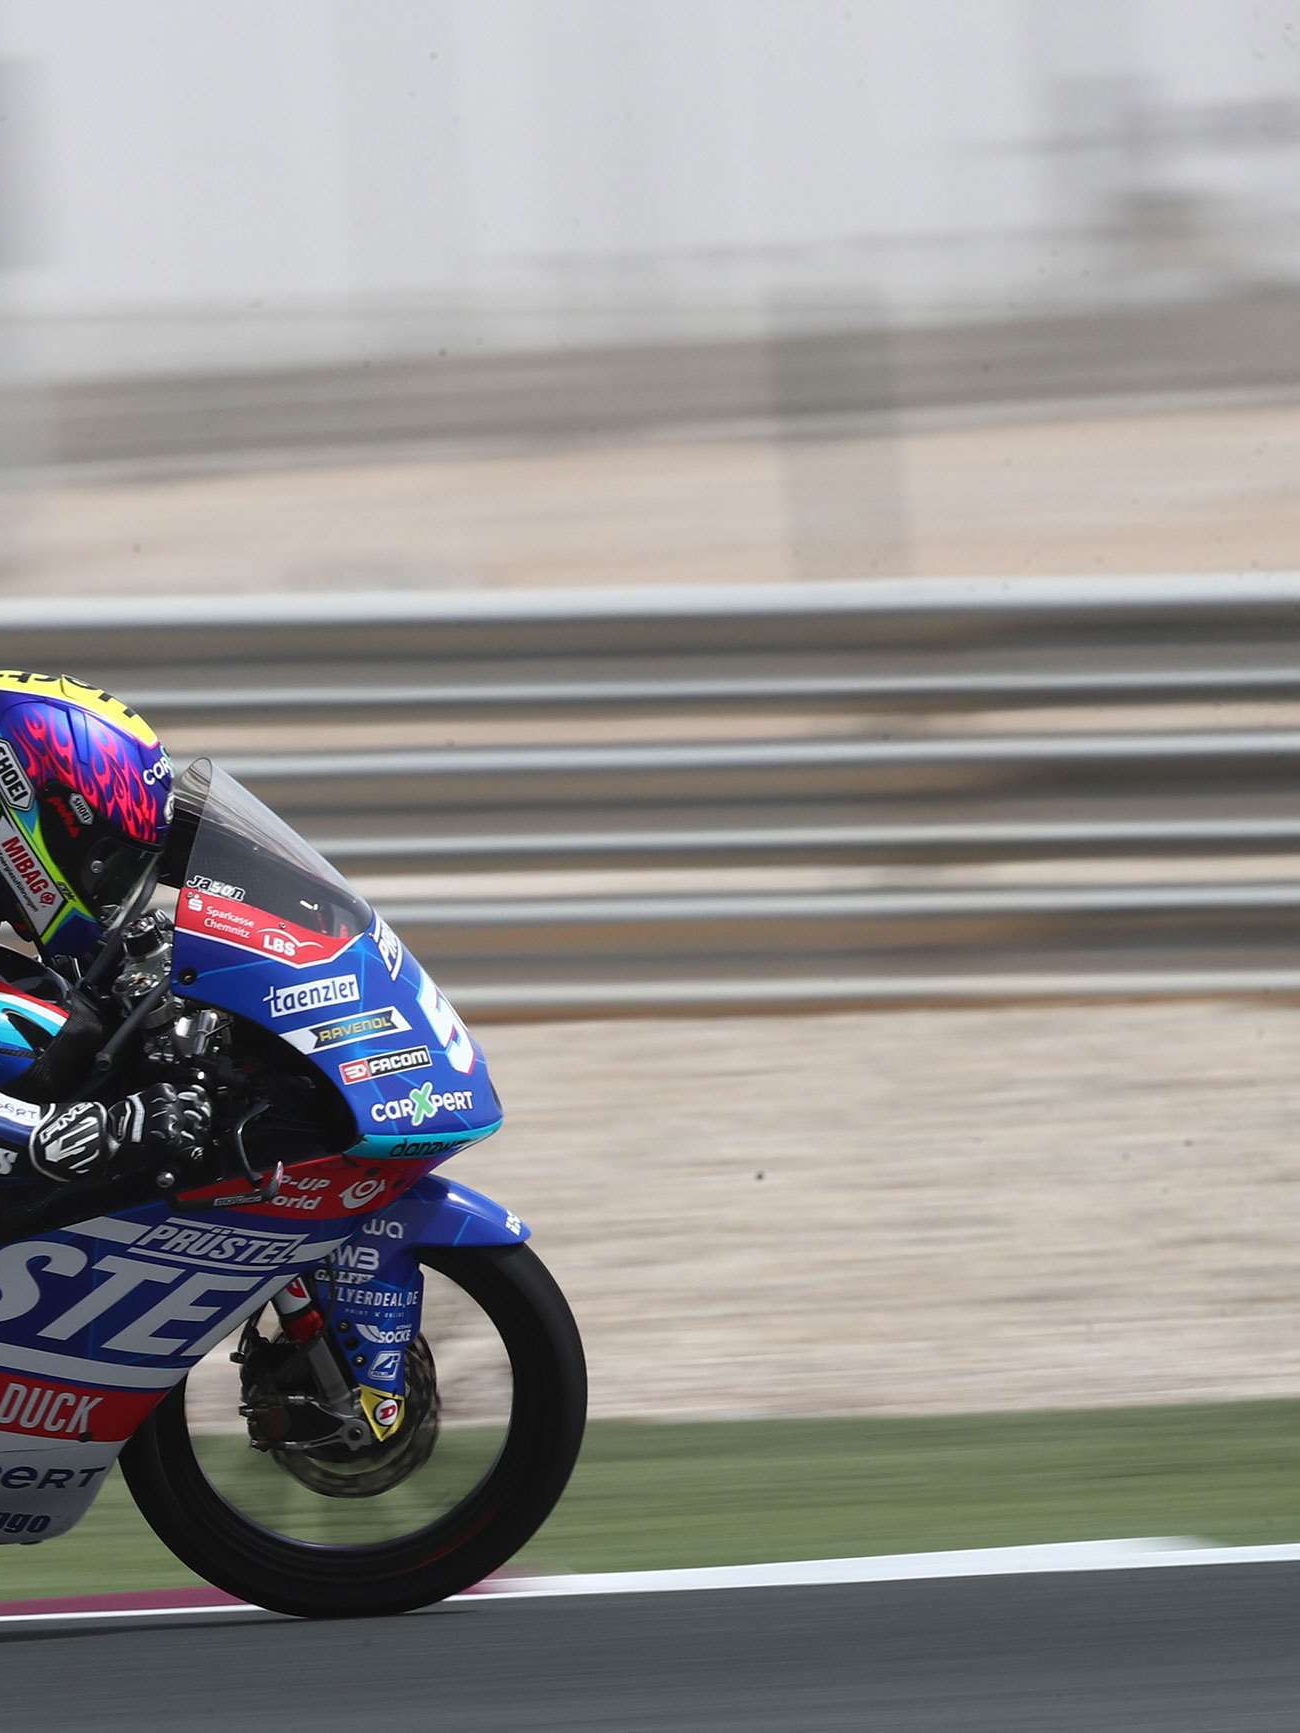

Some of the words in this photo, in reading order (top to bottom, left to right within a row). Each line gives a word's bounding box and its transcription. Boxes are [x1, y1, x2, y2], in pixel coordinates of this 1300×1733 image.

[74, 797, 91, 821] SHOEI
[2, 836, 49, 894] MIBAG
[206, 905, 255, 927] Sparkasse
[204, 918, 250, 938] Chemnitz
[263, 935, 296, 957] LBS
[266, 980, 356, 1012] taenzler
[318, 1016, 392, 1042] RAVENOL
[267, 1195, 324, 1210] orld
[141, 1226, 306, 1265] PRÜSTEL
[333, 1286, 420, 1308] LYERDEAL.DE
[378, 1329, 412, 1344] SOCKE
